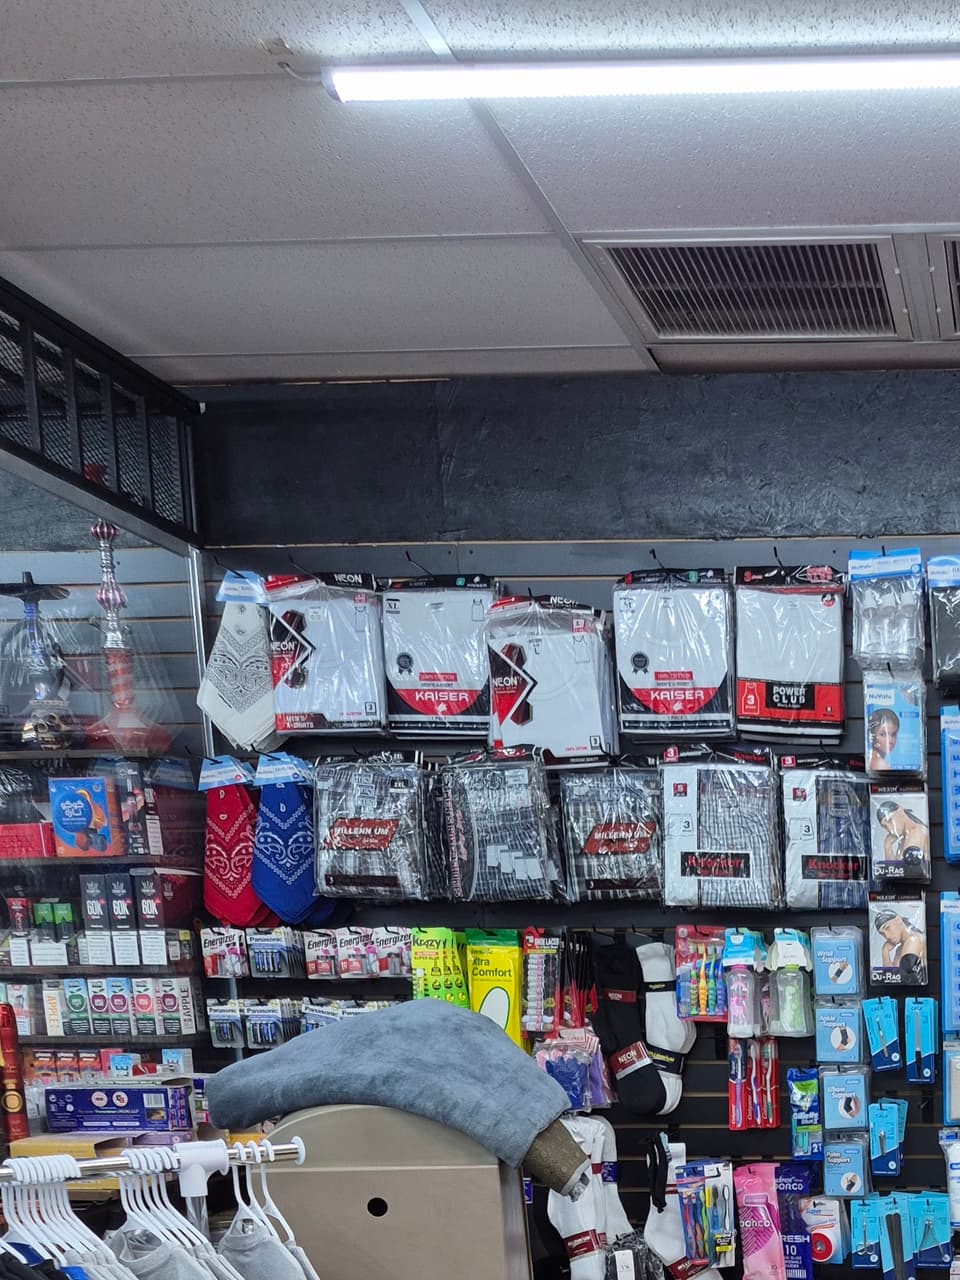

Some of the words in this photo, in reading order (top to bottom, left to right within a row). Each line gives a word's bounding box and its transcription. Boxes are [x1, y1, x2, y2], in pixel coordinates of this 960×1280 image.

[334, 573, 363, 584] NEON
[492, 677, 521, 687] NEON
[649, 690, 705, 700] KAISER
[772, 686, 807, 695] POWER
[415, 691, 470, 702] KAISER
[746, 694, 754, 705] 3
[772, 695, 807, 704] CLUB
[334, 827, 388, 836] MILLENNUM
[807, 858, 860, 871] Knocker
[203, 933, 237, 948] Energizer
[249, 935, 283, 944] Panasonic
[307, 936, 337, 951] Energiz
[339, 933, 373, 949] Energizer
[375, 932, 412, 947] Energizer
[412, 935, 442, 949] Krazy
[471, 957, 490, 966] Xtra
[471, 966, 512, 978] Comfort
[617, 1049, 637, 1064] NEON
[792, 1111, 820, 1121] Gillette
[781, 1234, 811, 1243] RESH
[785, 1244, 798, 1255] 10
